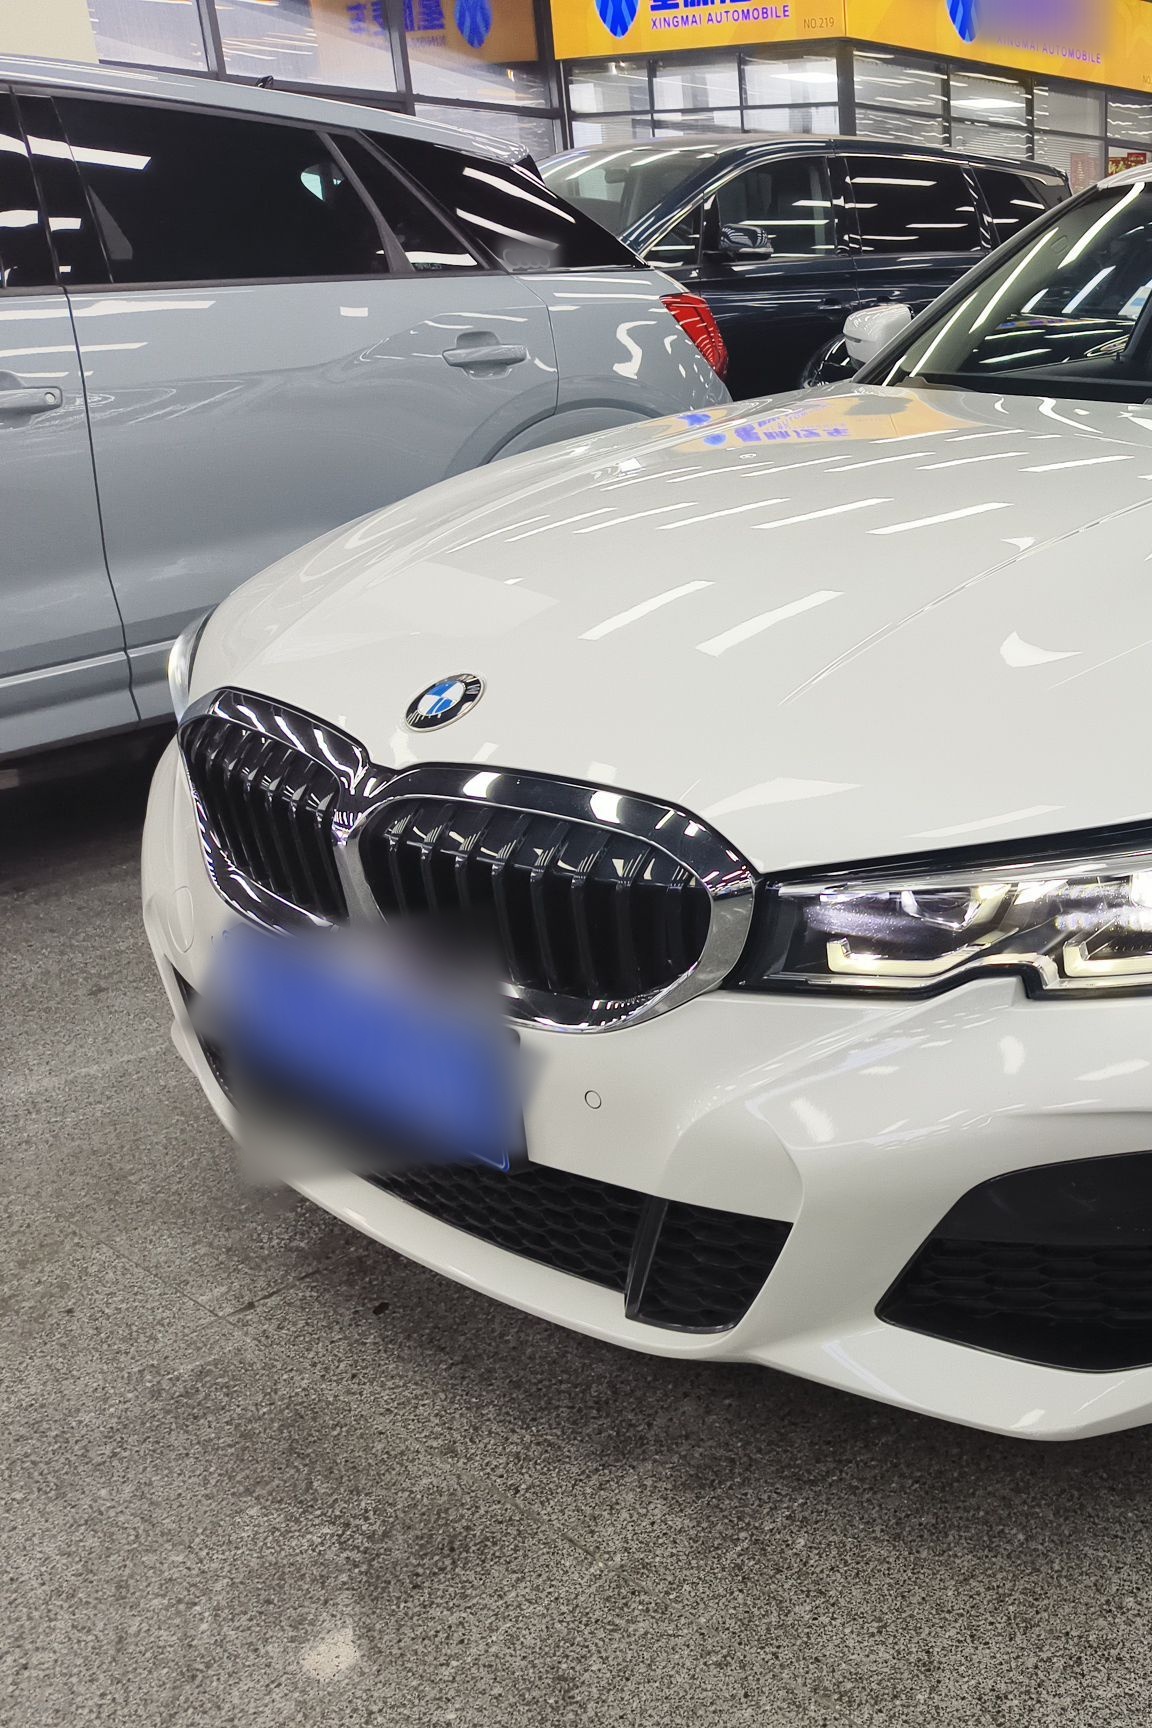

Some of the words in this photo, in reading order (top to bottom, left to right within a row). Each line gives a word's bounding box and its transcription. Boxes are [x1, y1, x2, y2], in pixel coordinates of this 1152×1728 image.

[651, 13, 702, 30] XINGMAI
[706, 4, 790, 24] AUTOMOBILE
[803, 16, 835, 30] NO.219
[1041, 43, 1102, 64] AUTOMOBILE
